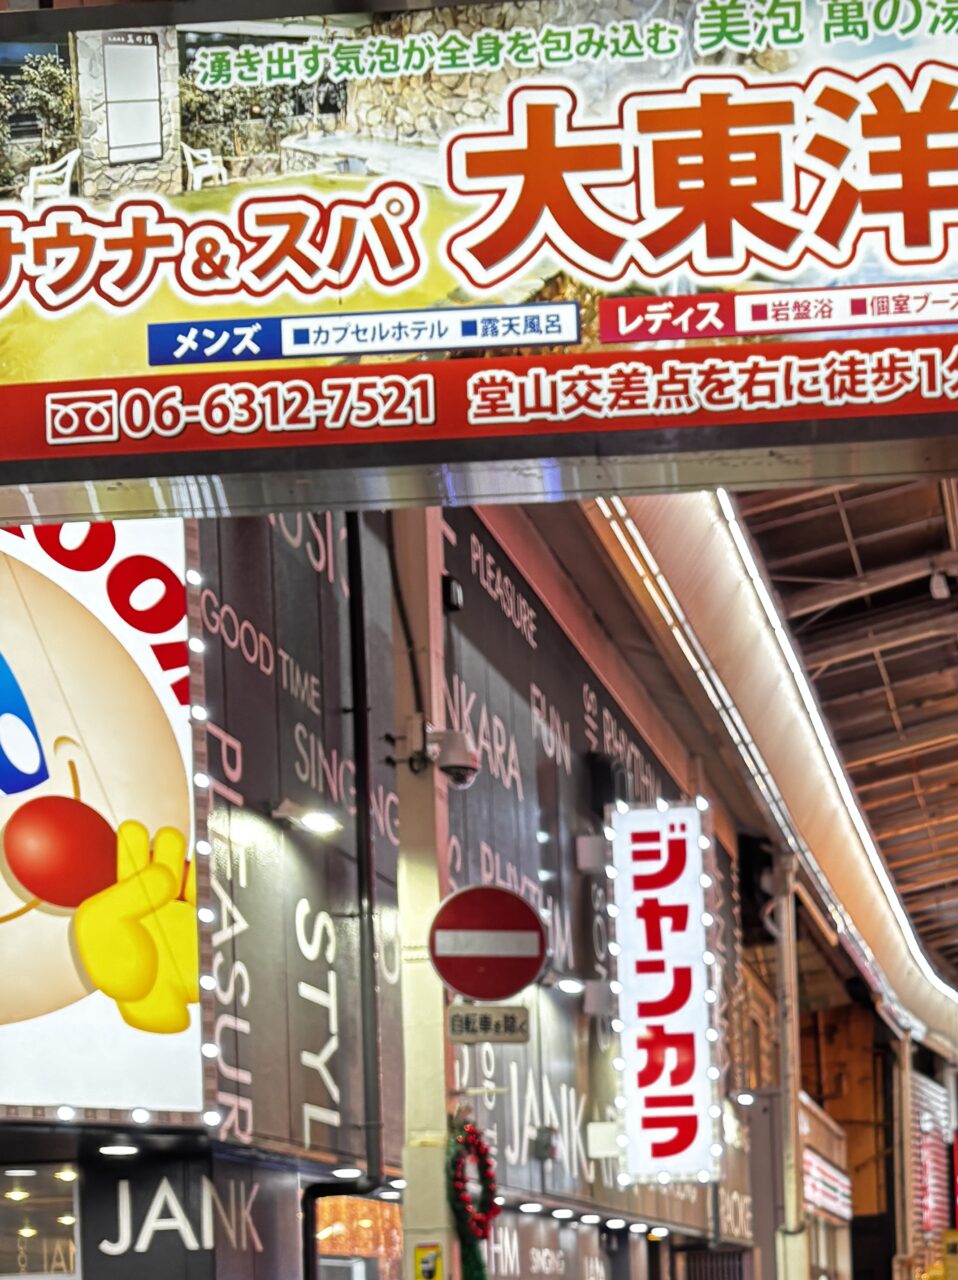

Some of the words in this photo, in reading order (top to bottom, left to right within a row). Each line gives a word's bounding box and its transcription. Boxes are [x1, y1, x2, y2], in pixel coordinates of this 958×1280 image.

[199, 22, 676, 85] 湧き出す気泡が全身を包み込む
[698, 0, 804, 49] 美泡
[172, 323, 262, 359] メンズ
[311, 320, 449, 347] カプセルホテル
[479, 316, 563, 339] 露天風呂
[616, 300, 726, 336] レディス
[770, 298, 834, 323] 岩盤浴
[121, 374, 437, 438] 06-6312-7521
[200, 588, 274, 676] GOOD
[277, 647, 321, 716] TIME
[630, 823, 699, 1159] ジャンカラ
[99, 1176, 264, 1254] JANK
